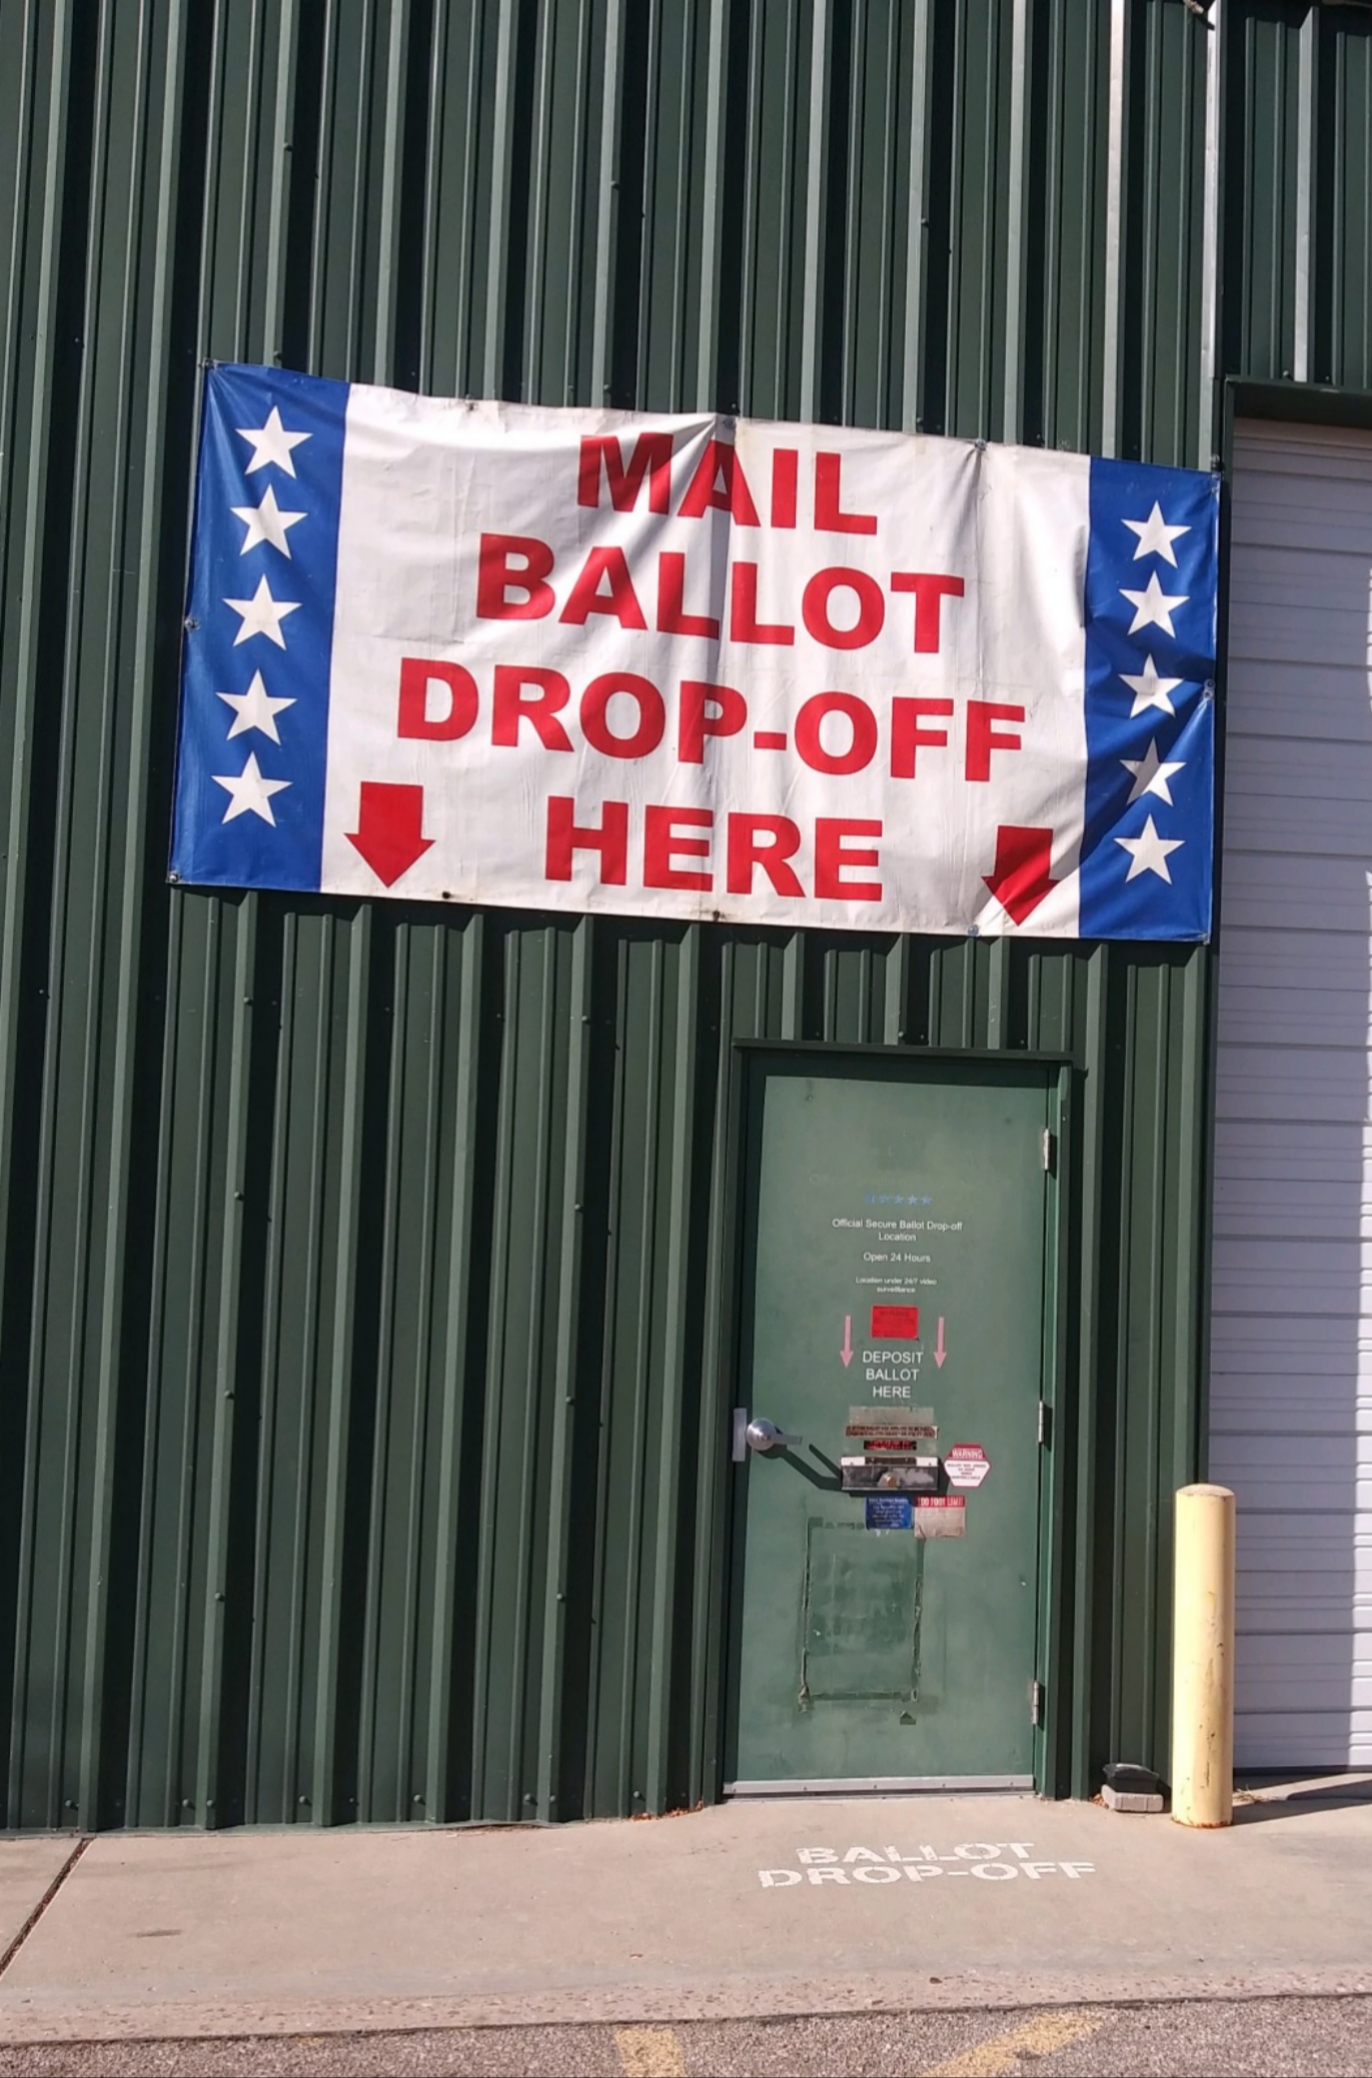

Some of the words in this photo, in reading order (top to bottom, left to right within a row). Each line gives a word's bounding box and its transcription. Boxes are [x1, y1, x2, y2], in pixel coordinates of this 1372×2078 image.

[578, 433, 877, 536] MAIL
[476, 533, 965, 654] BALLOT
[398, 657, 1026, 783] DROP-OFF
[545, 796, 883, 902] HERE
[832, 1218, 863, 1229] Official
[865, 1218, 898, 1229] Secure
[899, 1219, 925, 1231] Ballot
[926, 1220, 963, 1232] Drop-off
[878, 1231, 917, 1242] Location
[863, 1251, 888, 1263] Open
[890, 1252, 902, 1262] 24
[903, 1252, 931, 1263] Hours
[855, 1276, 883, 1285] Location
[862, 1350, 924, 1364] DEPOSIT
[865, 1368, 920, 1381] BALLOT
[872, 1386, 911, 1398] HERE
[951, 1447, 984, 1460] WARNING
[796, 1842, 1035, 1865] BALLOT
[758, 1862, 1096, 1888] DROP-OFF
